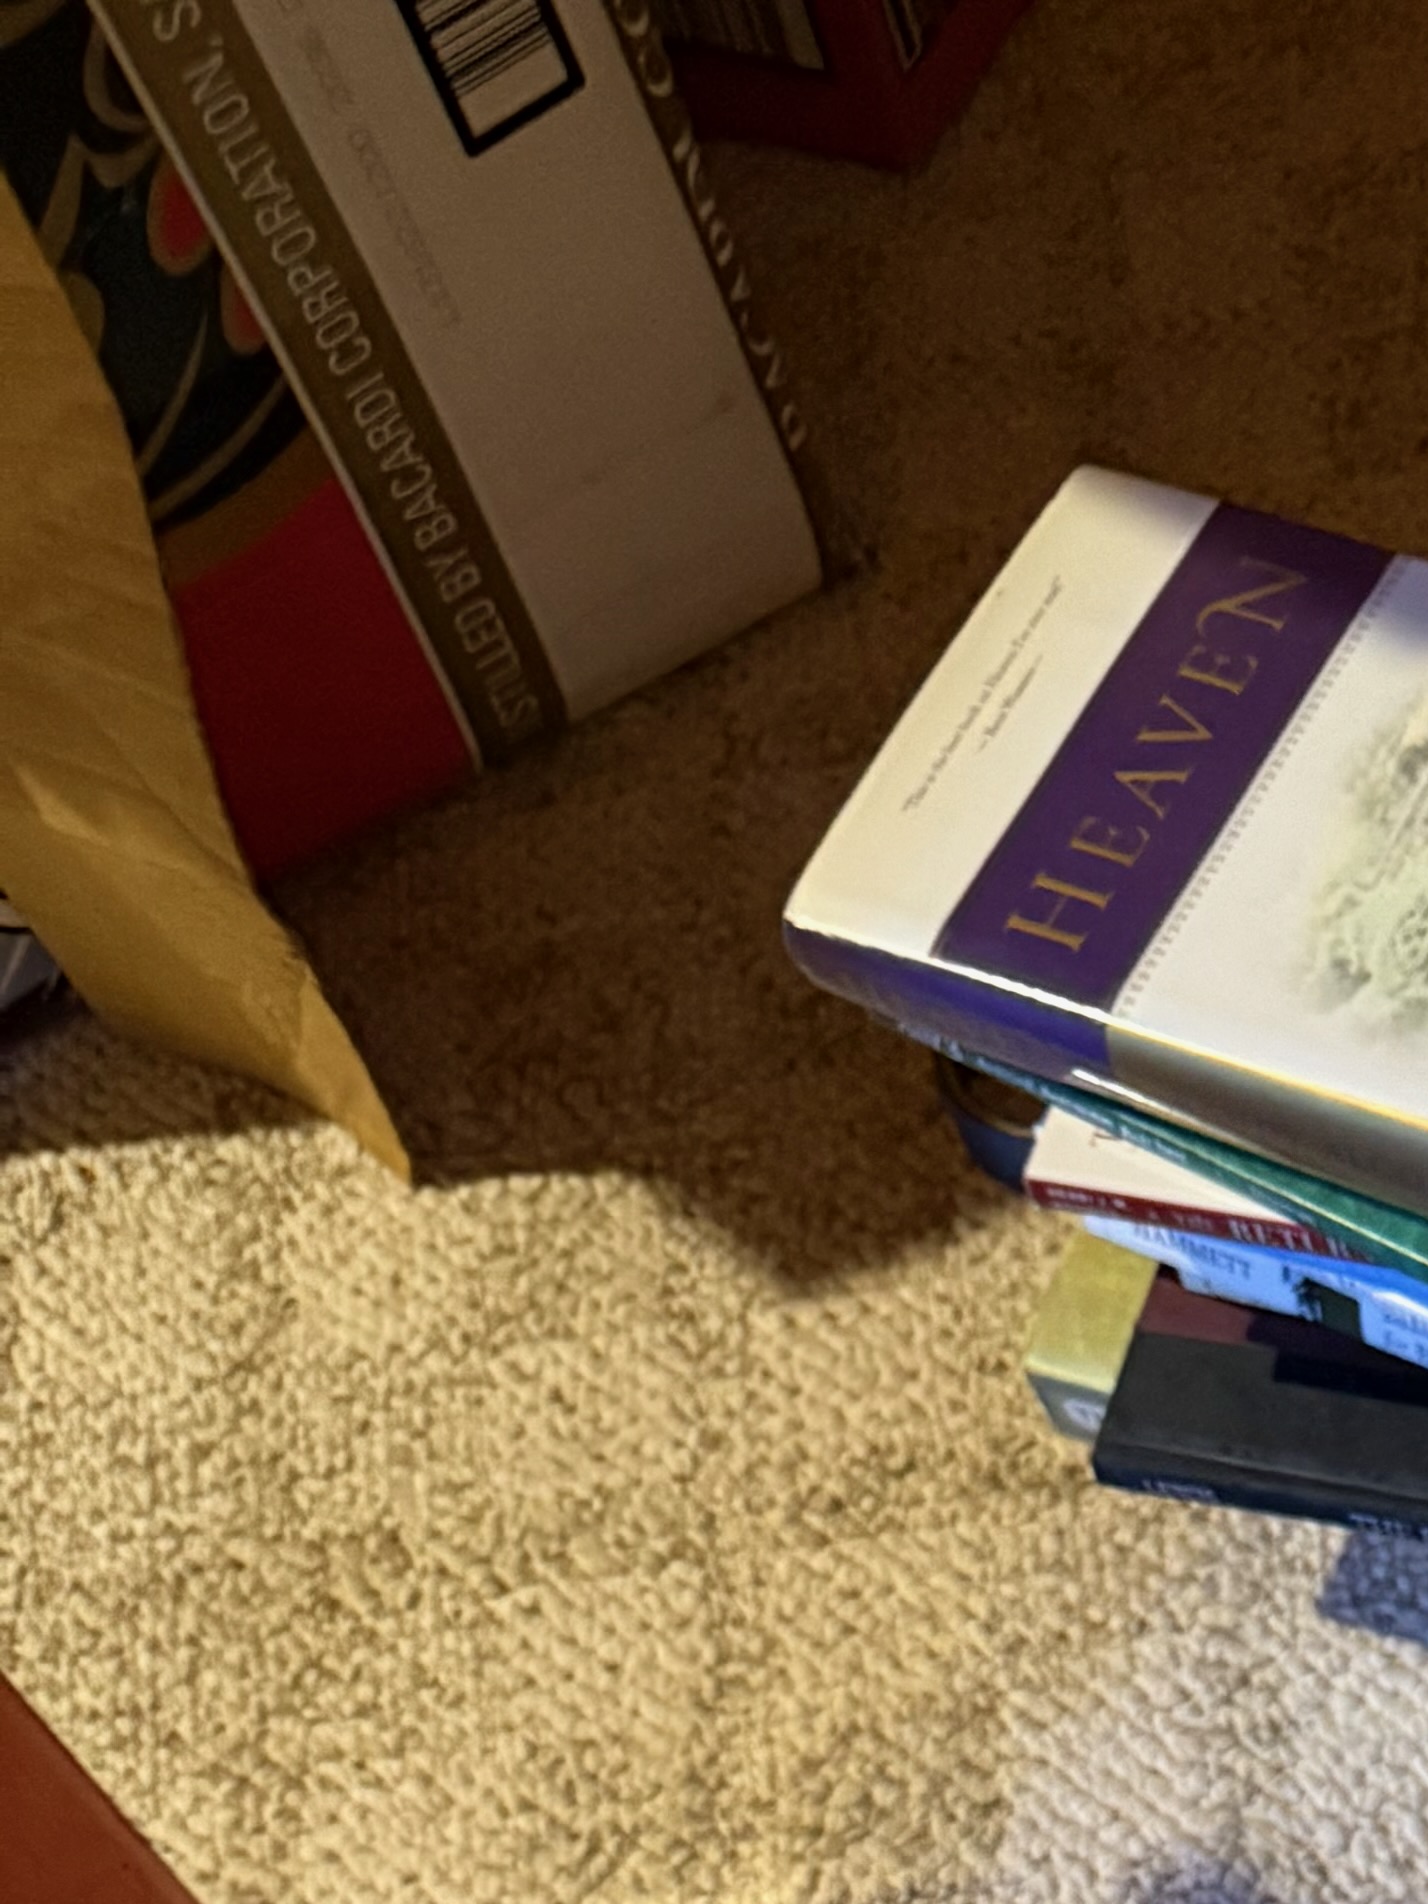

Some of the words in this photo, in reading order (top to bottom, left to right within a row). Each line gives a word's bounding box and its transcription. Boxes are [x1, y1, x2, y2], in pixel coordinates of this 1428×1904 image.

[343, 364, 461, 556] BACARDI
[418, 540, 494, 604] BY
[1003, 553, 1312, 953] HEAVEN
